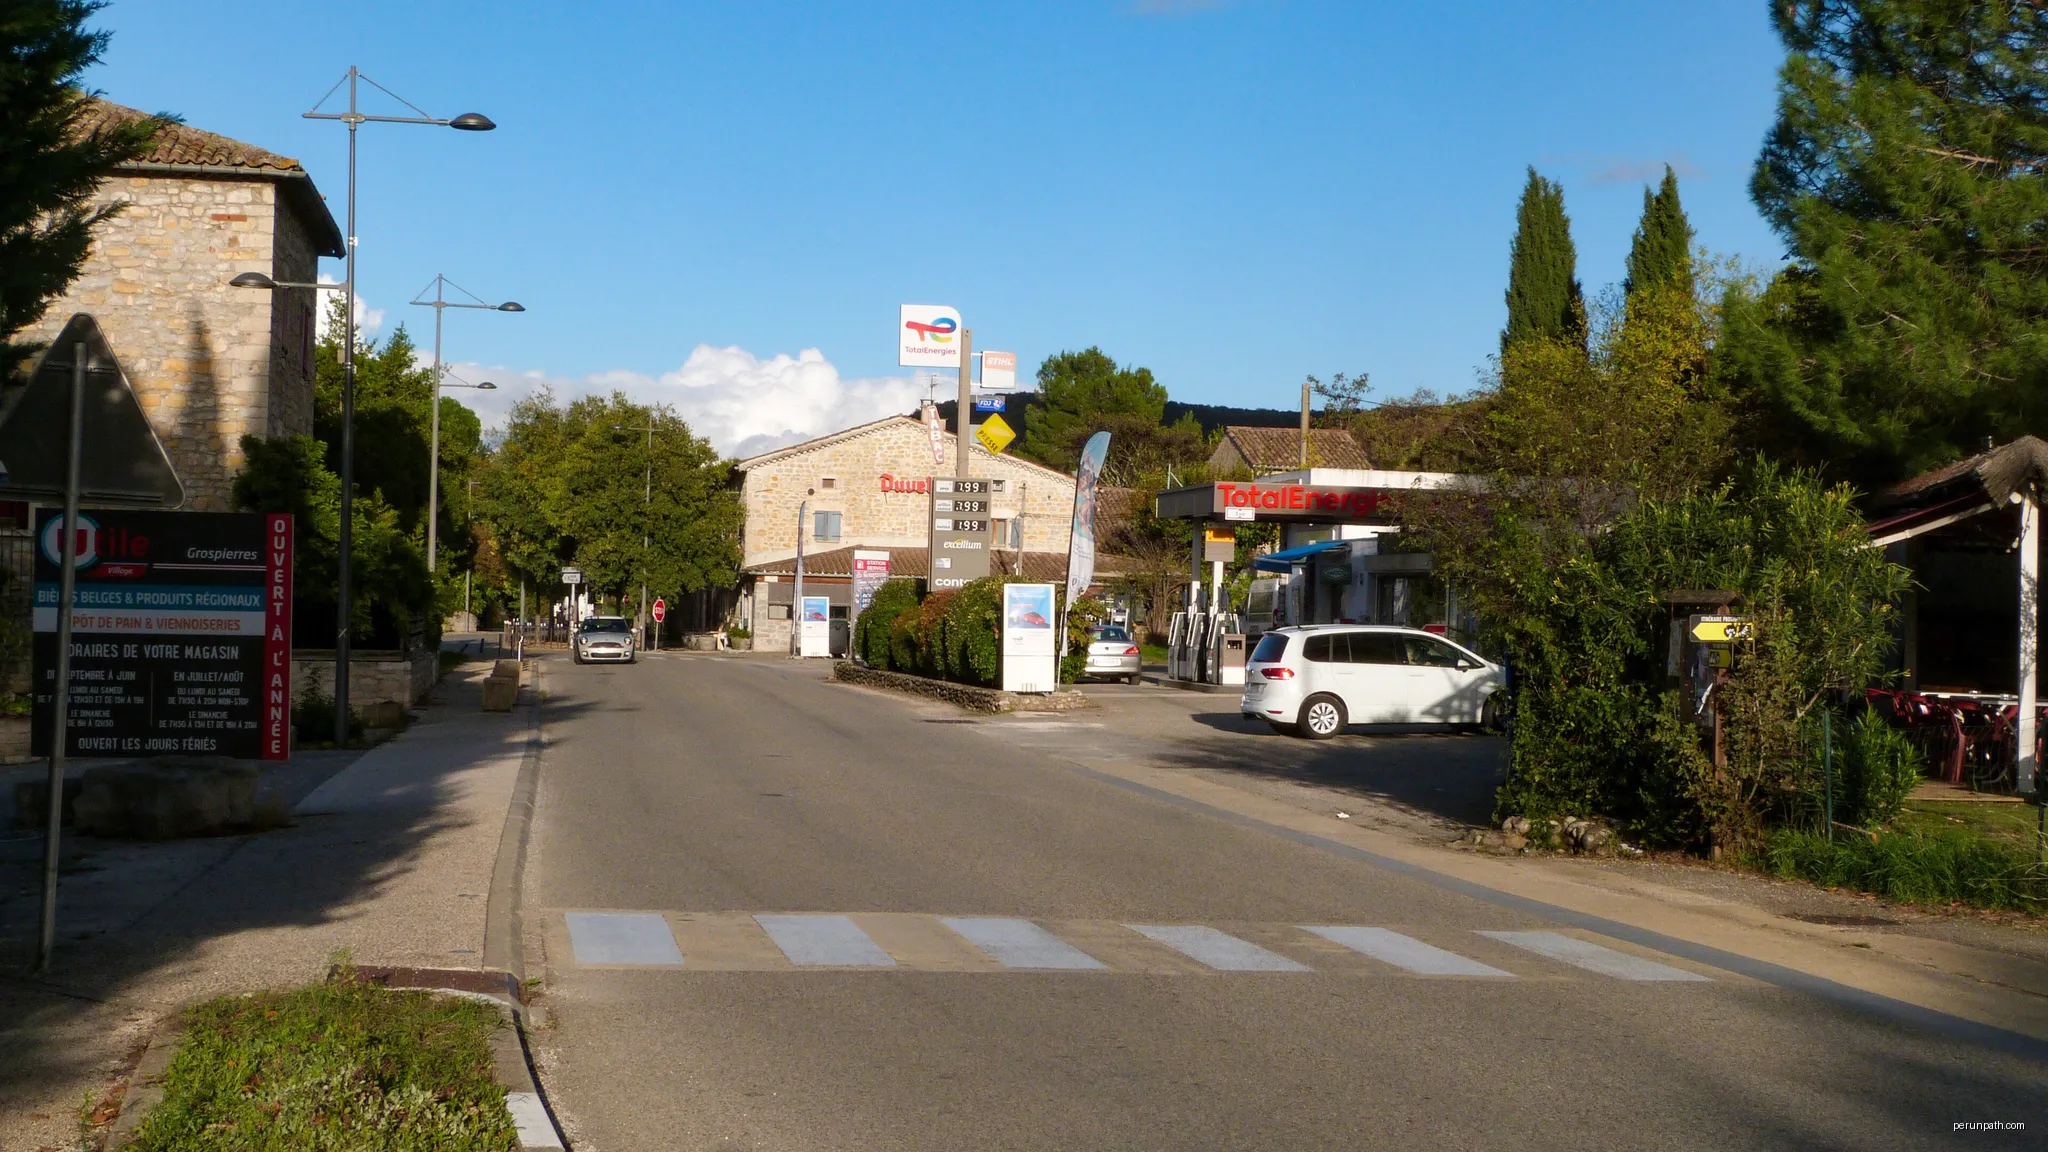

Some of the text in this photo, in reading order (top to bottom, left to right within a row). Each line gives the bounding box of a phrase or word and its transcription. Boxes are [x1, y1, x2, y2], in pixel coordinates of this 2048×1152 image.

[905, 346, 957, 356] TotalEnergies
[986, 357, 1014, 366] STIHL
[928, 408, 944, 462] TABAC
[978, 430, 999, 452] PRESSE
[880, 473, 932, 494] Duvel
[943, 539, 982, 550] excellium
[187, 547, 258, 561] Grospierres
[273, 519, 286, 616] OUVERT
[81, 591, 122, 604] BELGES
[125, 592, 134, 604] &
[136, 592, 193, 605] PRODUITS
[195, 591, 261, 607] RÉGIONAUX
[97, 617, 113, 628] DE
[115, 617, 142, 629] PAIN
[145, 618, 153, 629] &
[156, 617, 241, 631] VIENNOISERIES
[272, 624, 284, 641] À
[68, 643, 239, 660] ORAIRES DE VOTRE MAGASIN
[116, 670, 136, 681] JUIN
[173, 671, 185, 682] EN
[90, 686, 99, 694] AU
[100, 686, 124, 695] SAMEDI
[187, 688, 206, 696] LUNDI
[207, 688, 216, 696] AU
[218, 688, 241, 696] SAMEDI
[95, 696, 103, 704] ET
[104, 696, 113, 704] DE
[80, 710, 111, 718] DIMANCHE
[188, 711, 229, 719] LE DIMANCHE
[206, 721, 214, 729] ET
[78, 736, 217, 752] OUVERT LES JOURS FÉRIÉS
